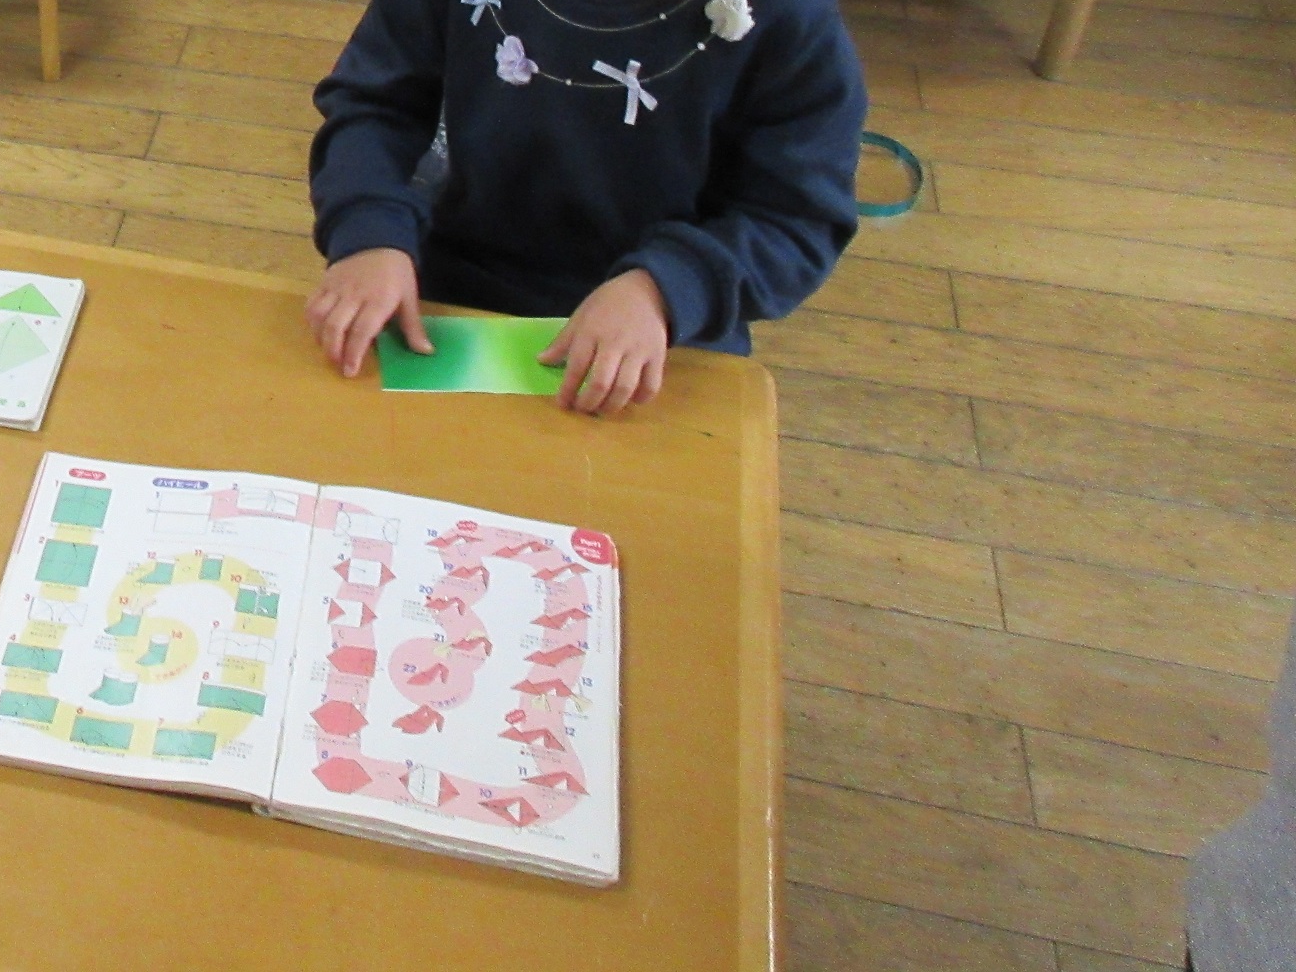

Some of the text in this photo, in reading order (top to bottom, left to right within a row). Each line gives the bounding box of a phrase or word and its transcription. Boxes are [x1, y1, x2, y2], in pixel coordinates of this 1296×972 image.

[427, 528, 438, 537] 18
[443, 562, 453, 571] 19
[419, 584, 433, 594] 20
[434, 633, 445, 643] 21
[404, 663, 417, 673] 22
